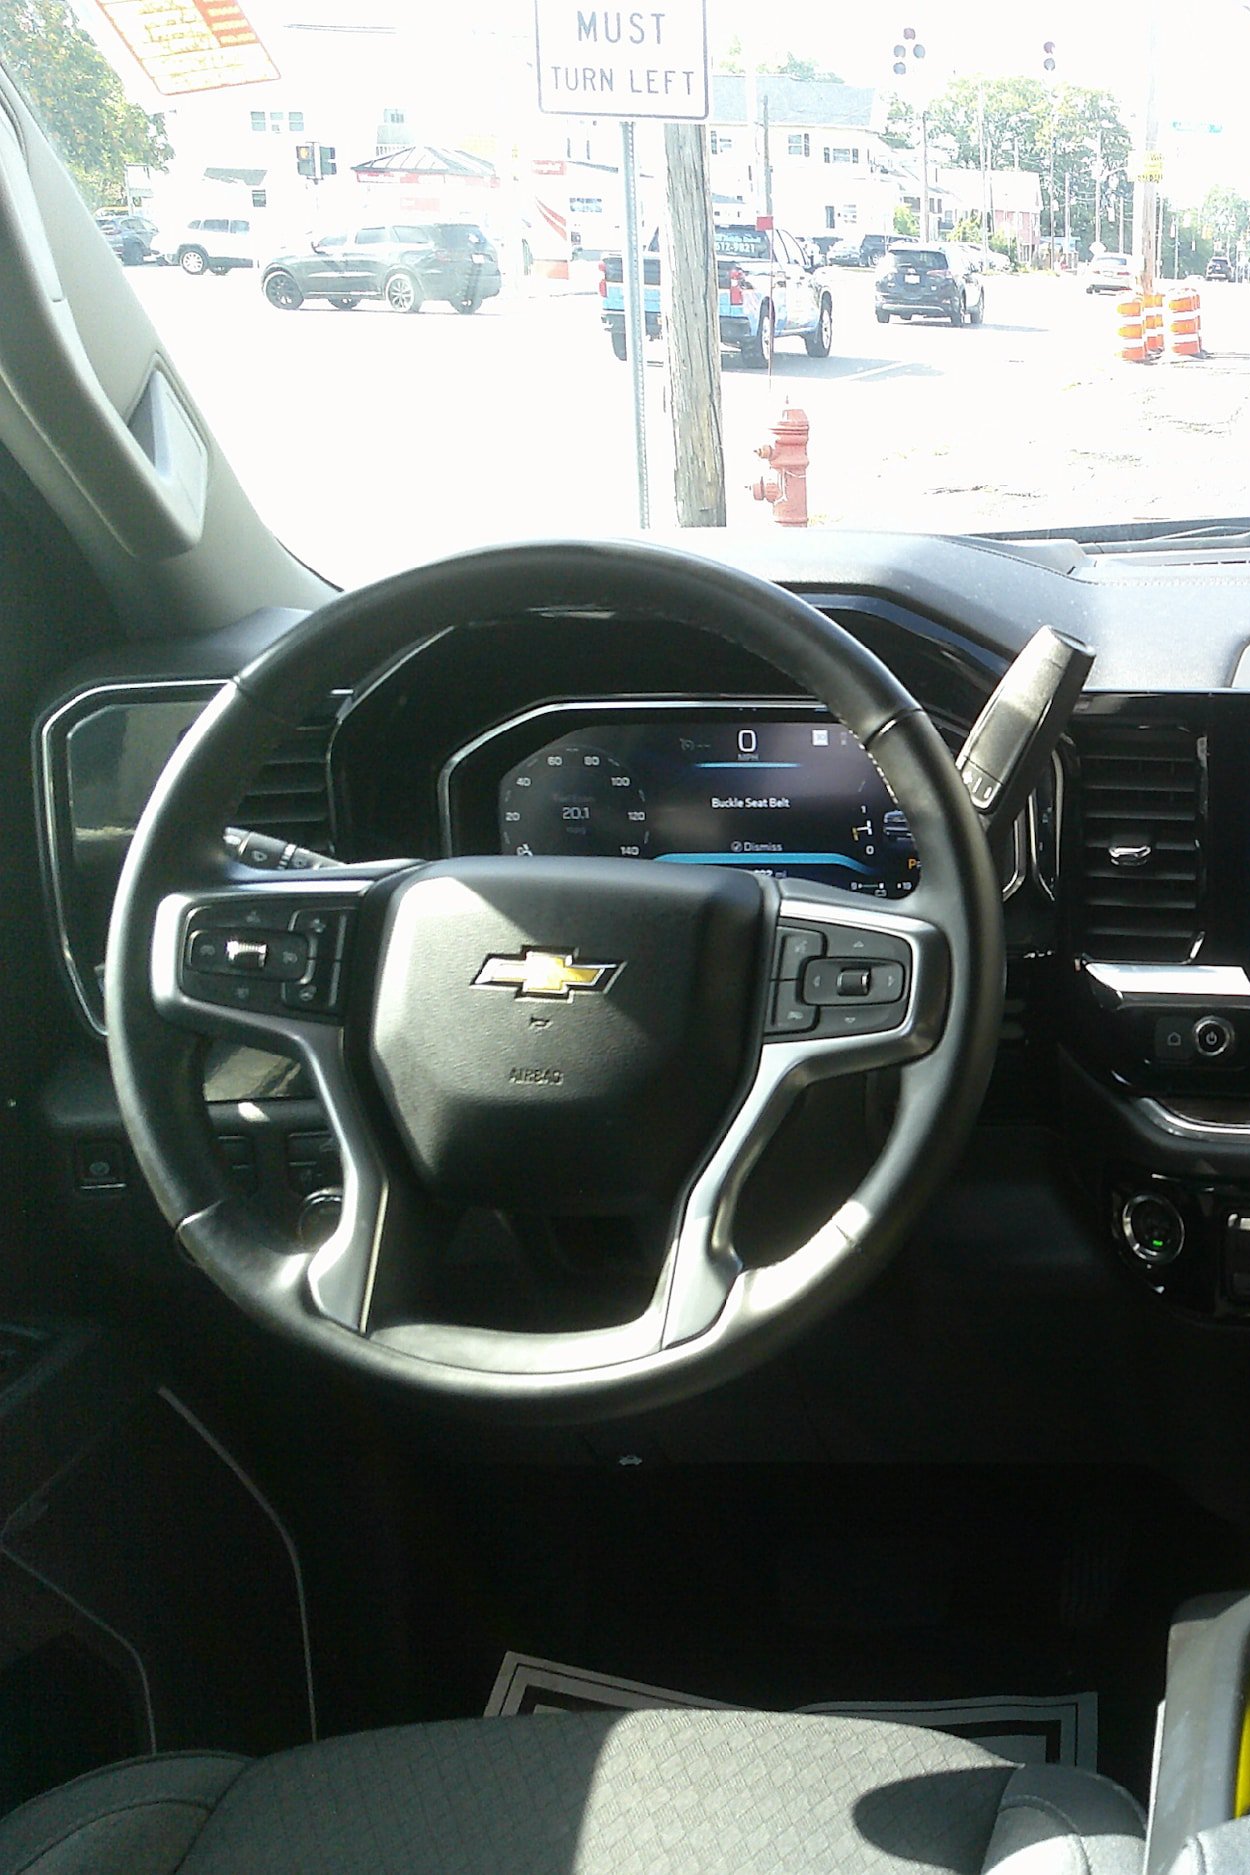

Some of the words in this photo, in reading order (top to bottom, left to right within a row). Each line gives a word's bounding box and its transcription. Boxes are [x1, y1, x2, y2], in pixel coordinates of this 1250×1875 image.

[577, 11, 665, 44] MUST
[551, 66, 614, 91] TURN
[630, 69, 694, 95] LEFT
[738, 729, 757, 753] 0
[547, 756, 563, 766] 60
[584, 756, 600, 766] 80
[516, 777, 532, 787] 40
[611, 777, 631, 787] 100
[711, 798, 744, 809] Buckle
[745, 798, 768, 809] Seat
[769, 798, 791, 809] Belt
[505, 812, 521, 822] 20
[562, 807, 590, 820] 20.1
[620, 846, 640, 856] 140
[743, 842, 783, 852] Dismiss
[509, 1066, 564, 1086] AIRBAG
